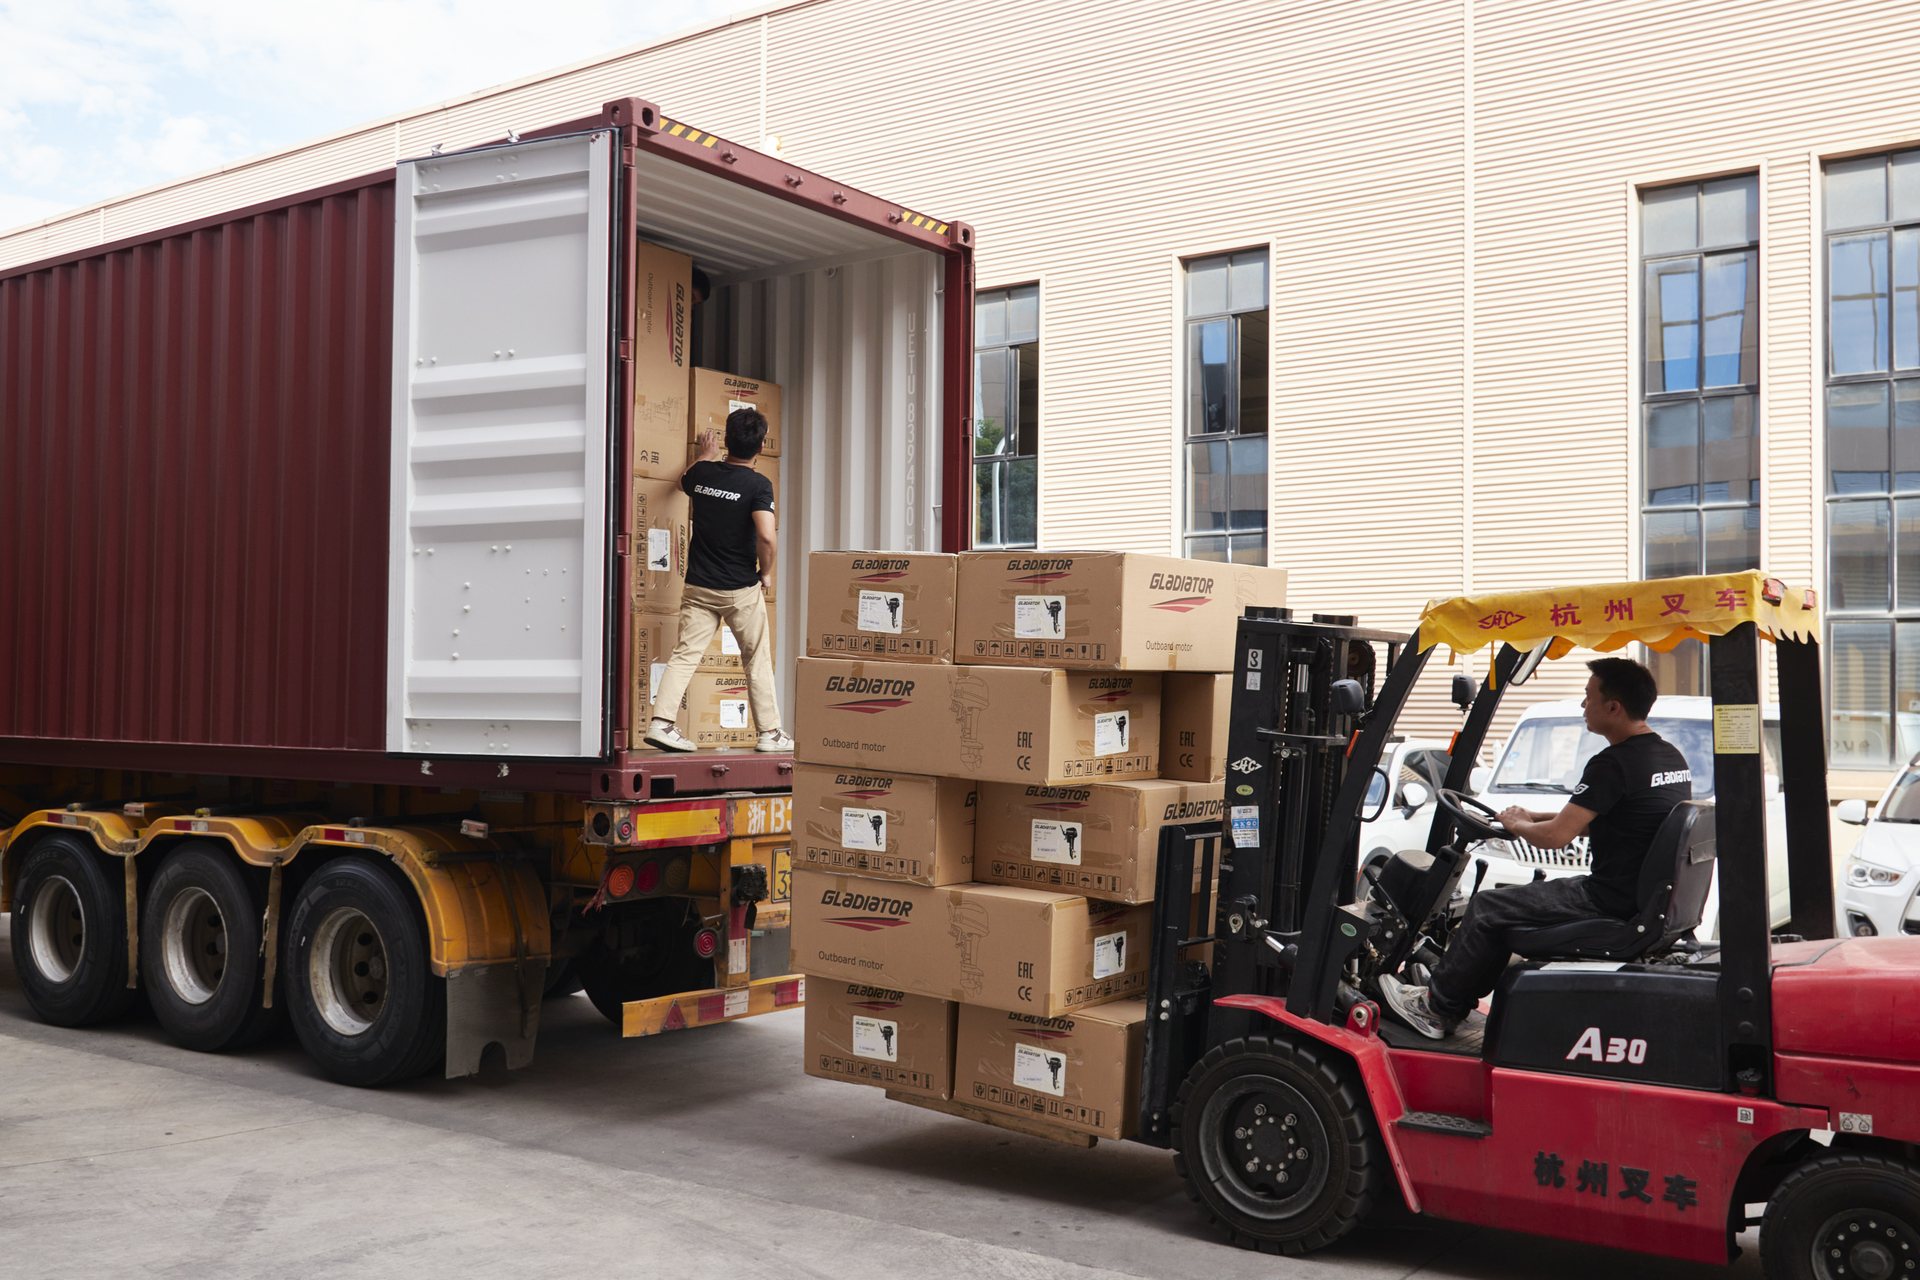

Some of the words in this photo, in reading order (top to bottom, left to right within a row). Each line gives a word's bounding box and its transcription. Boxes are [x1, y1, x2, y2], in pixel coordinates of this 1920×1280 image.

[674, 282, 685, 367] GLADIATOR
[724, 378, 759, 391] GLADIATOR
[694, 484, 741, 501] GLADIATOR
[852, 560, 910, 570] GLADIATOR
[1007, 560, 1073, 570] GLADIATOR
[1149, 573, 1214, 594] GLADIATOR
[1551, 588, 1748, 627] 杭州叉车
[1146, 641, 1174, 651] Outboard
[1175, 643, 1193, 652] motor
[716, 678, 747, 686] GLADIATO
[825, 676, 915, 696] GLADIATOR
[1088, 678, 1133, 689] GLADIATOR
[822, 737, 859, 750] Outboard
[861, 743, 886, 752] motor
[1017, 755, 1031, 771] CE
[835, 774, 893, 789] GLADIATOR
[1651, 769, 1691, 788] GLADIATO
[1025, 785, 1090, 801] GLADIATOR
[778, 870, 792, 895] 3
[821, 889, 913, 917] GLADIATOR
[818, 951, 857, 966] Outboard
[858, 959, 884, 970] motor
[847, 985, 905, 1001] GLADIATOR
[1018, 986, 1032, 1002] CE
[1566, 1027, 1648, 1064] A30
[1534, 1151, 1698, 1211] 杭州叉车
